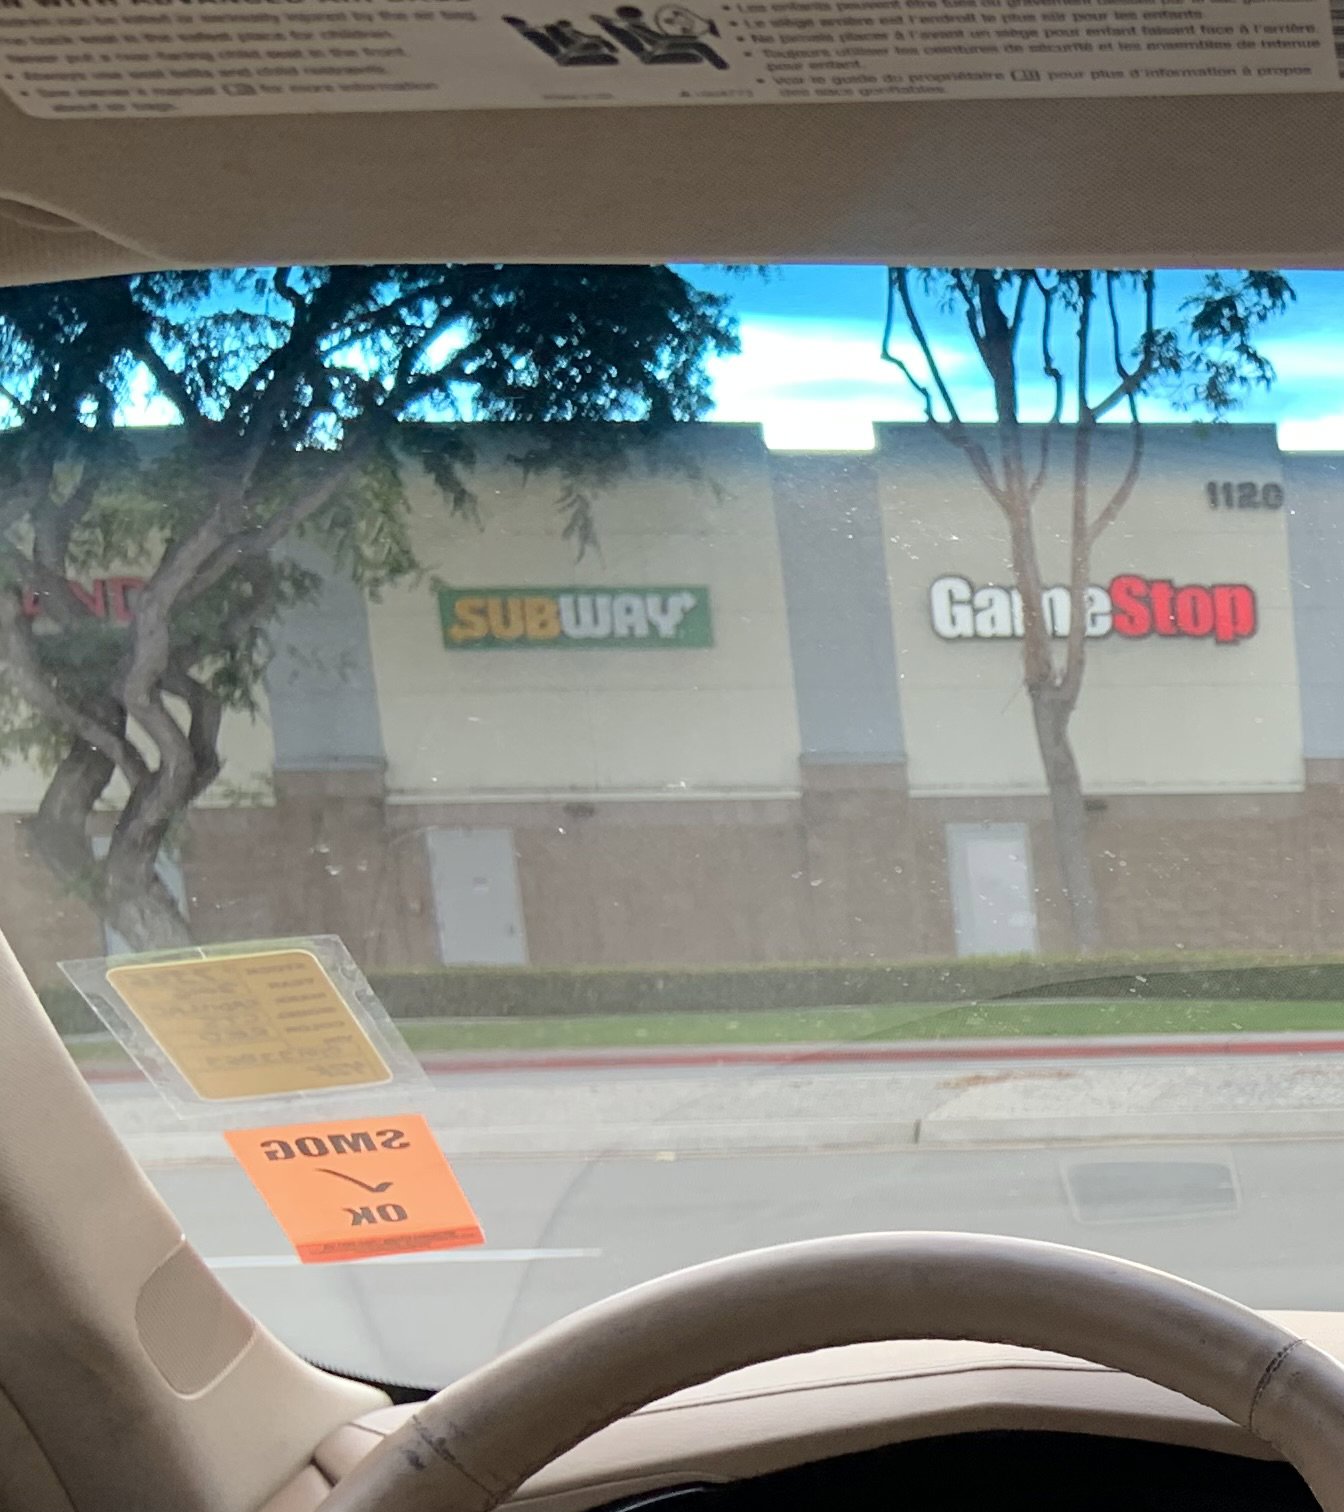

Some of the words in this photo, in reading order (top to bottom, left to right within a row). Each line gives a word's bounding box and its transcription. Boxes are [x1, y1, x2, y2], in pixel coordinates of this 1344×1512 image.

[1207, 481, 1284, 510] 1120
[449, 592, 697, 641] SUBWAY
[930, 575, 1258, 643] GameStop
